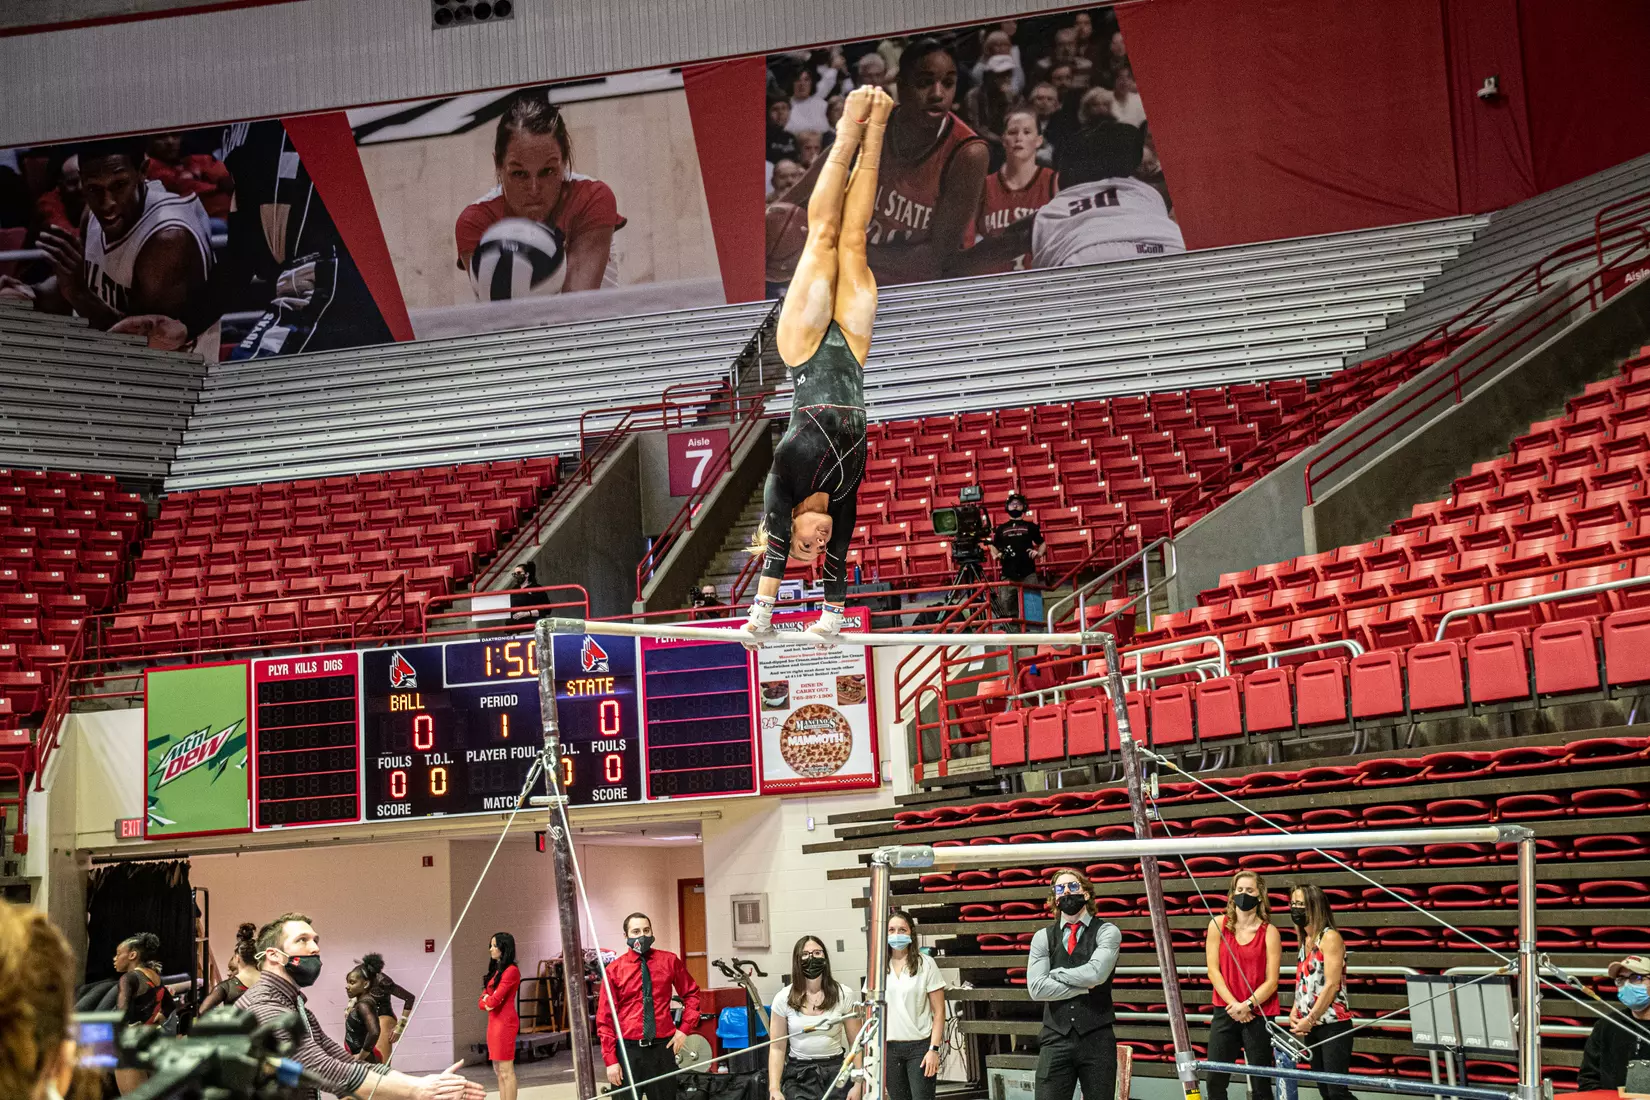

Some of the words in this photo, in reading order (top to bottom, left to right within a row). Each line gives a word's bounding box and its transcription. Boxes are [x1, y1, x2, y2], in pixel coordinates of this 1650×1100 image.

[883, 189, 933, 230] STATE
[1068, 187, 1120, 216] 30
[239, 312, 274, 349] HOYAS
[687, 437, 710, 447] Aisle
[685, 449, 713, 488] 7
[481, 634, 517, 643] DAKTRONICS
[485, 640, 539, 677] 1:50
[268, 664, 289, 677] PLYR
[295, 661, 317, 674] KILLS
[323, 659, 343, 672] DIGS
[566, 677, 615, 696] STATE
[390, 693, 425, 711] BALL
[480, 694, 518, 709] PERIOD
[502, 713, 509, 738] 1
[600, 700, 620, 735] 0
[796, 718, 837, 731] MANCINO'S
[414, 715, 433, 750] 0
[787, 733, 844, 746] MAMMOTH
[466, 748, 507, 762] PLAYER
[591, 739, 627, 753] FOULS
[378, 756, 412, 769] FOULS
[424, 753, 454, 766] T.O.L.
[606, 754, 621, 782] 0
[391, 770, 407, 798] 0
[431, 767, 447, 795] 0
[483, 795, 521, 809] MATCH
[592, 788, 628, 801] SCORE
[377, 803, 412, 816] SCORE
[122, 819, 141, 837] EXIT
